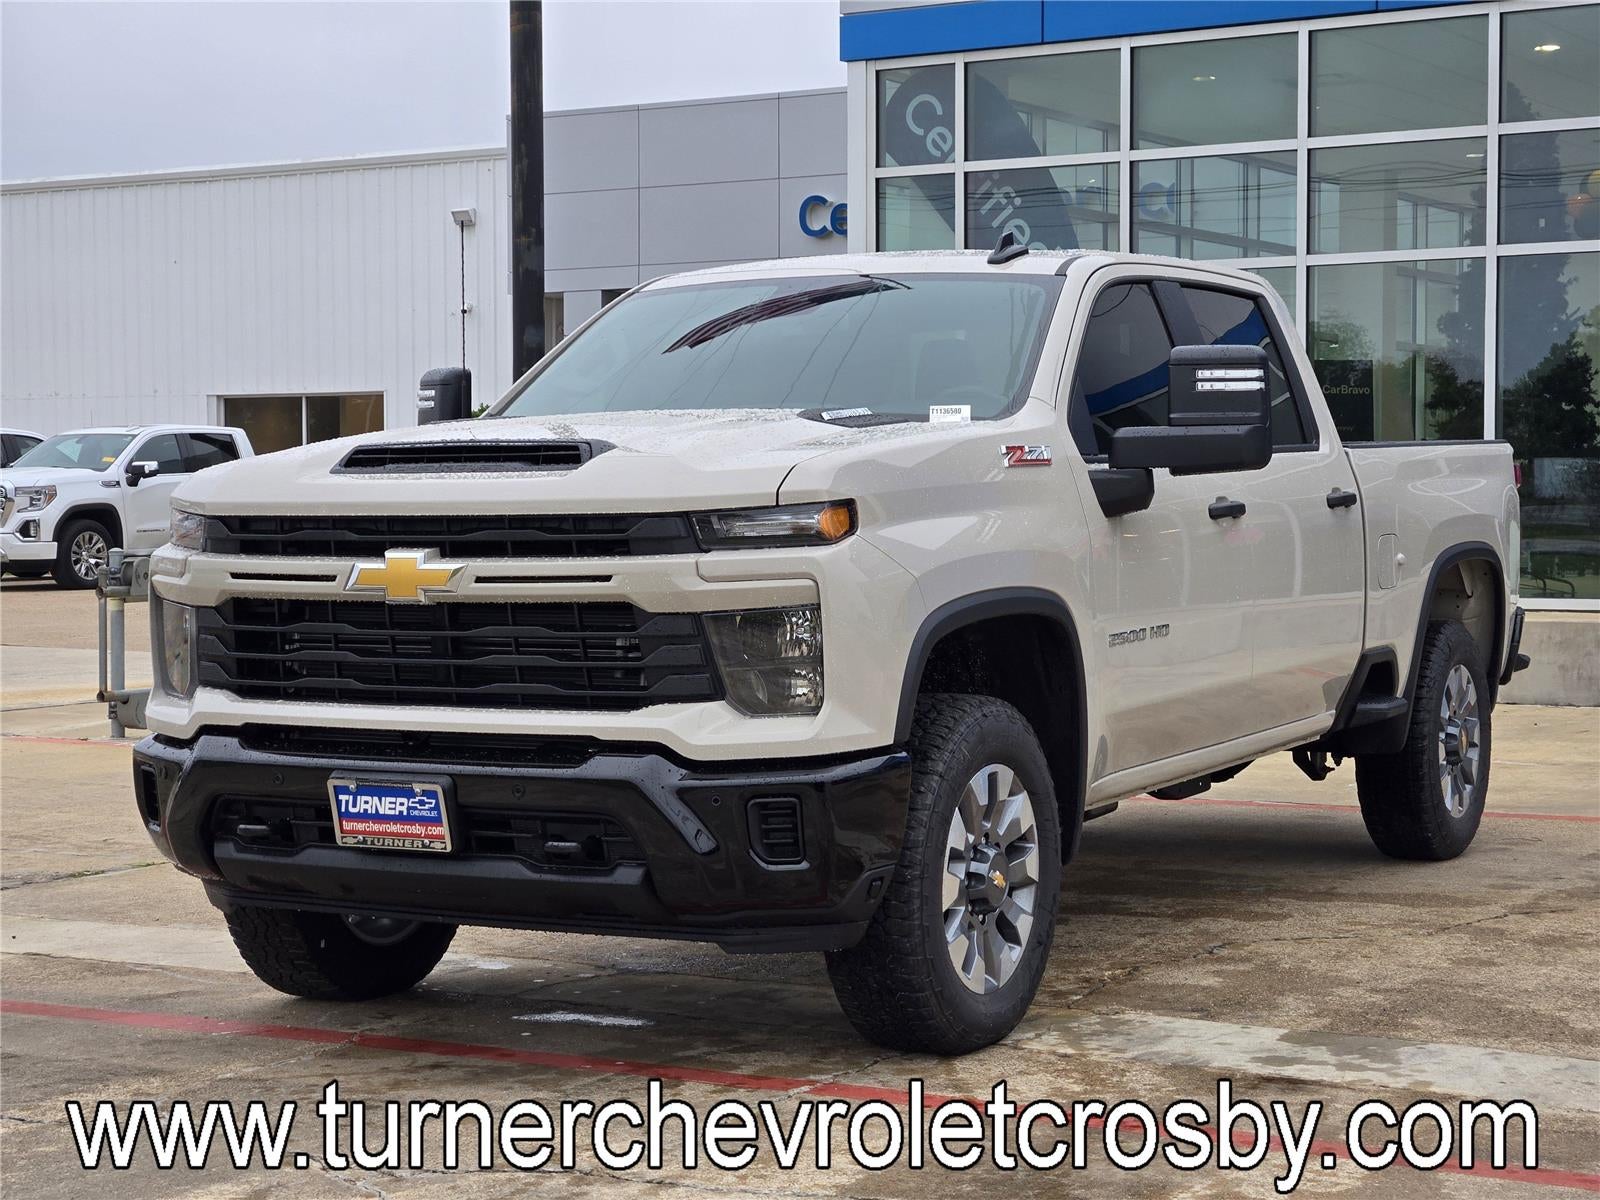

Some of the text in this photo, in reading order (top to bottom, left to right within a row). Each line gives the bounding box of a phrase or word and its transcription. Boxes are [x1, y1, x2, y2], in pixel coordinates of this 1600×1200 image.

[1323, 384, 1370, 394] CarBravo
[1000, 444, 1052, 468] Z71
[1108, 623, 1170, 648] 2500 HD
[338, 794, 408, 816] TURNER
[409, 809, 438, 817] CHEVROLET
[342, 820, 444, 837] turnerchevroletcrosby.com
[365, 837, 422, 848] TURNER
